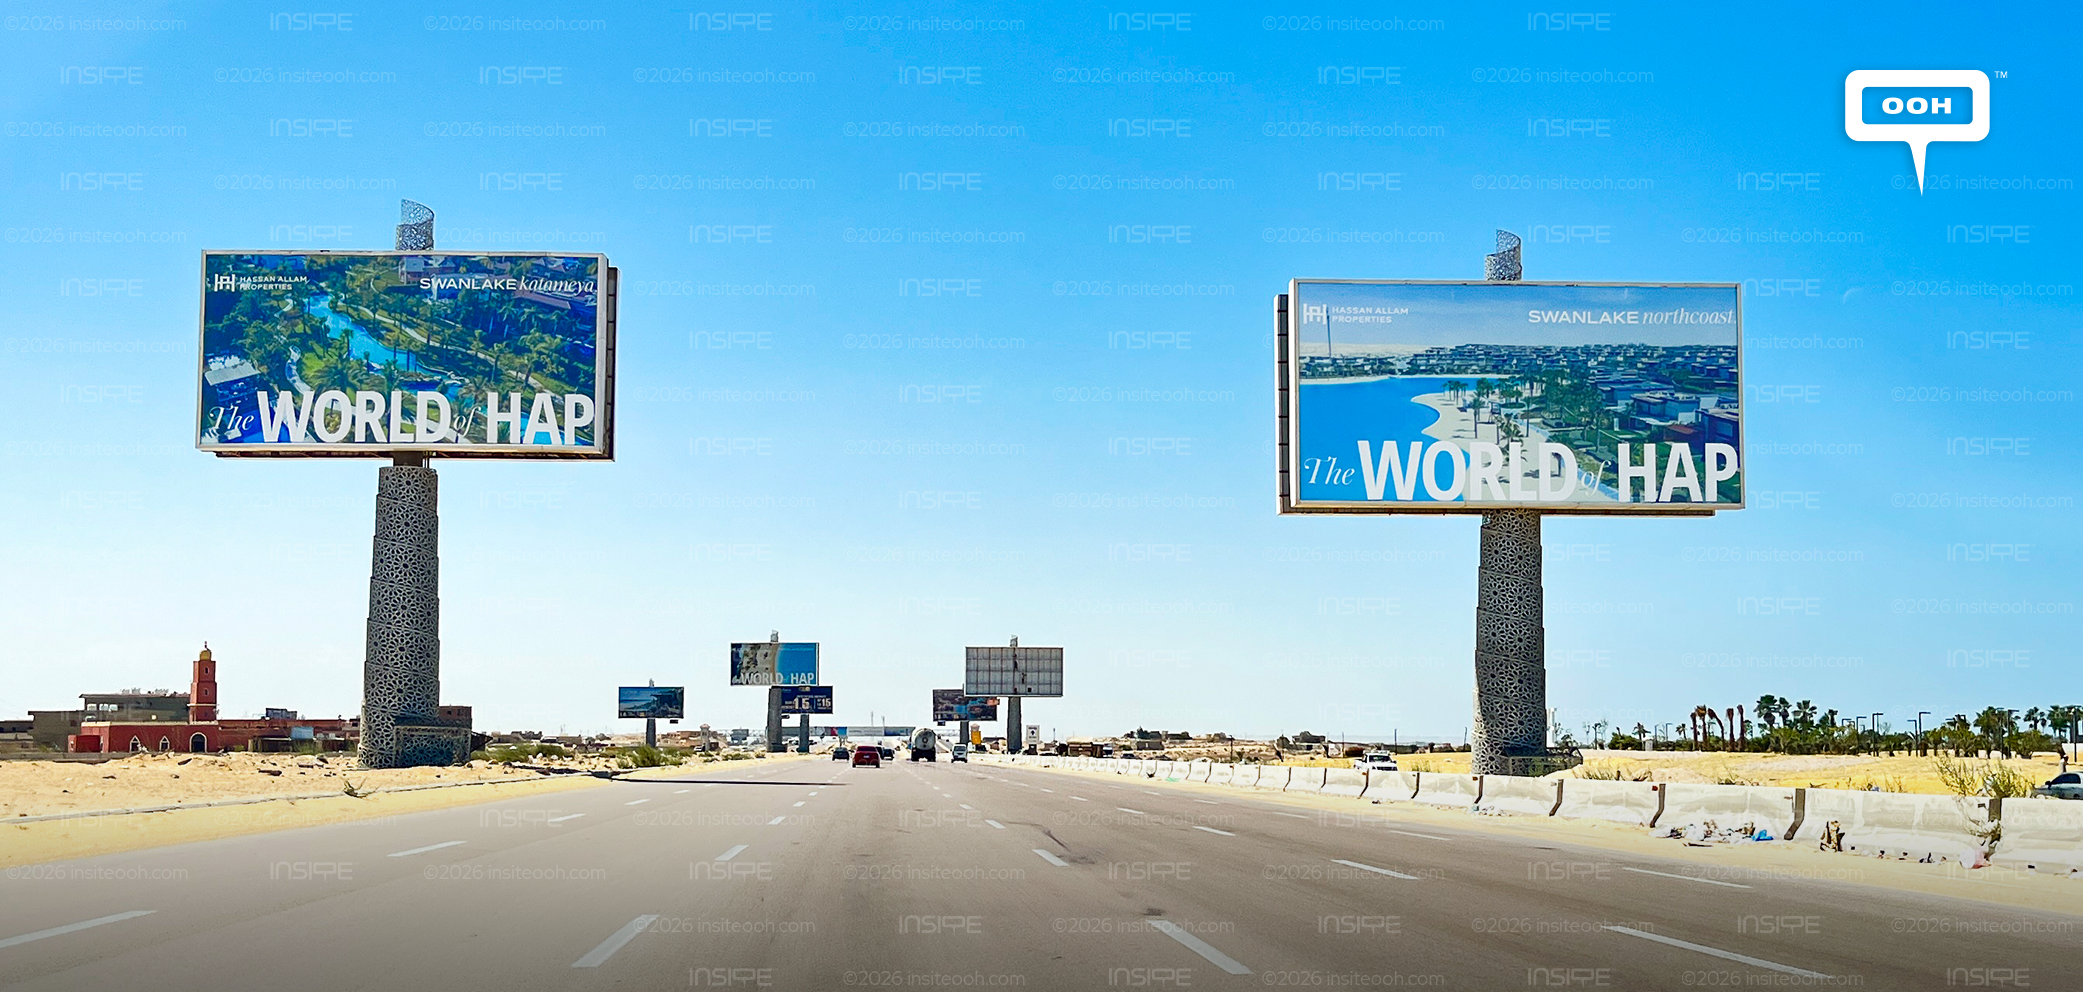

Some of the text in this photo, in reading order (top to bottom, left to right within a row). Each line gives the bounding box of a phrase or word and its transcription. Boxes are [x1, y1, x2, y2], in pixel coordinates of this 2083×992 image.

[239, 275, 307, 283] HASSAN ALLAM
[420, 278, 517, 290] SWANLAKE
[239, 283, 293, 291] PROPERTIES
[1332, 306, 1409, 315] HASSAN ALLAM
[1332, 316, 1392, 324] PROPERTIES
[1528, 310, 1639, 325] SWANLAKE
[209, 390, 595, 445] The WORLD of HAP
[1304, 439, 1739, 504] The WORLD of HAP
[741, 672, 784, 684] WORLD
[790, 672, 815, 685] HAP
